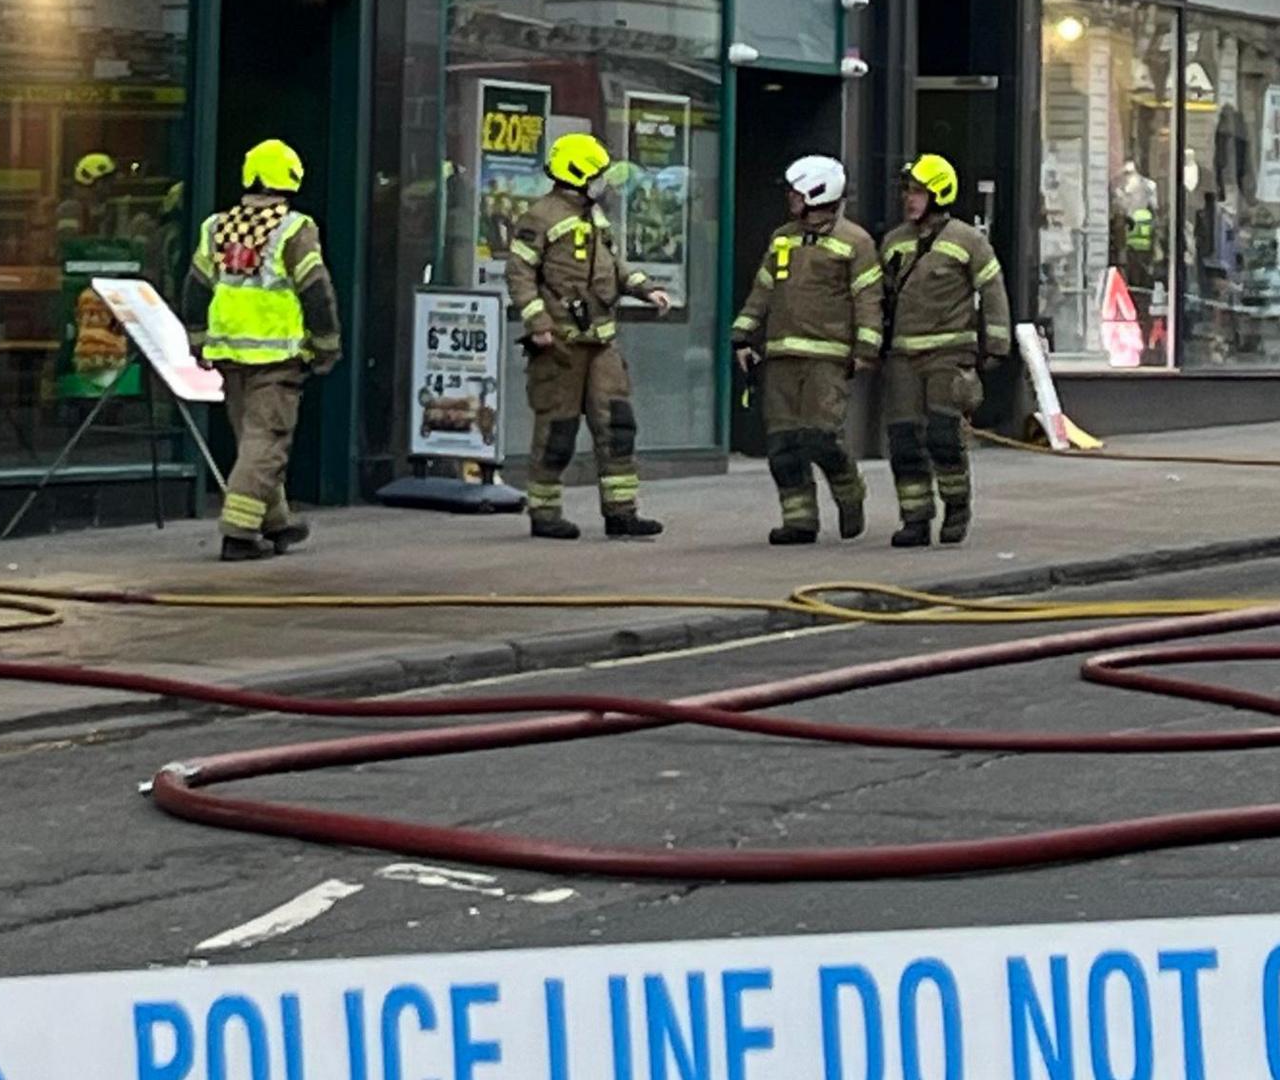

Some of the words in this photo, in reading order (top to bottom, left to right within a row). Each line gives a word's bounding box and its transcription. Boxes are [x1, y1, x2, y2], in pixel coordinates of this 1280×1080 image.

[450, 328, 487, 352] SUB
[819, 958, 964, 1080] DO
[1006, 949, 1218, 1080] NOT
